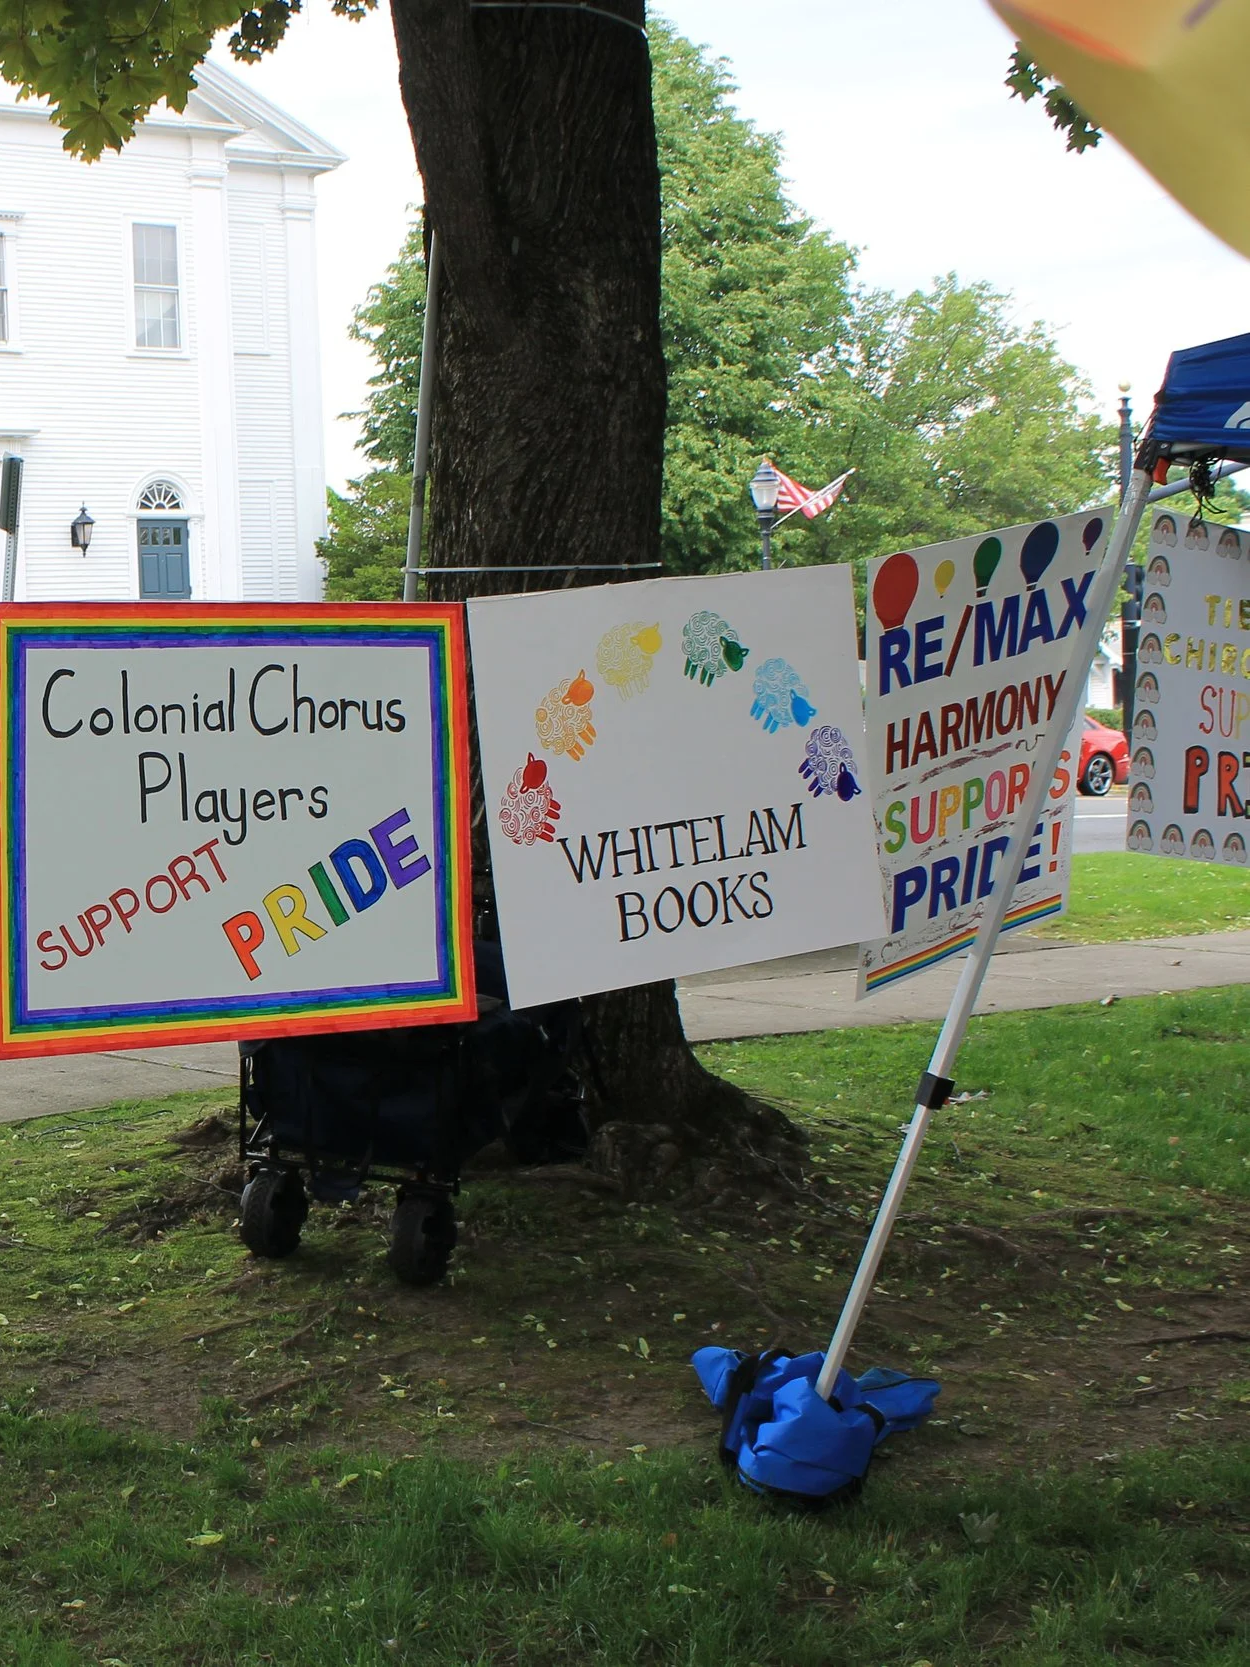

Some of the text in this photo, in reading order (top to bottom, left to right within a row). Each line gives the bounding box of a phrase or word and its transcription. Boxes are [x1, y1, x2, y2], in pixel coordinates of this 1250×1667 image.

[879, 570, 1096, 697] RE/MAX
[41, 664, 406, 739] Colonial Chorus
[886, 669, 1067, 776] HARMONY
[138, 751, 329, 845] Players
[557, 802, 807, 884] WHITELAM
[884, 751, 1070, 854] SUPPORS
[36, 808, 431, 981] SUPPORT PRIDE
[615, 871, 773, 942] BOOKS
